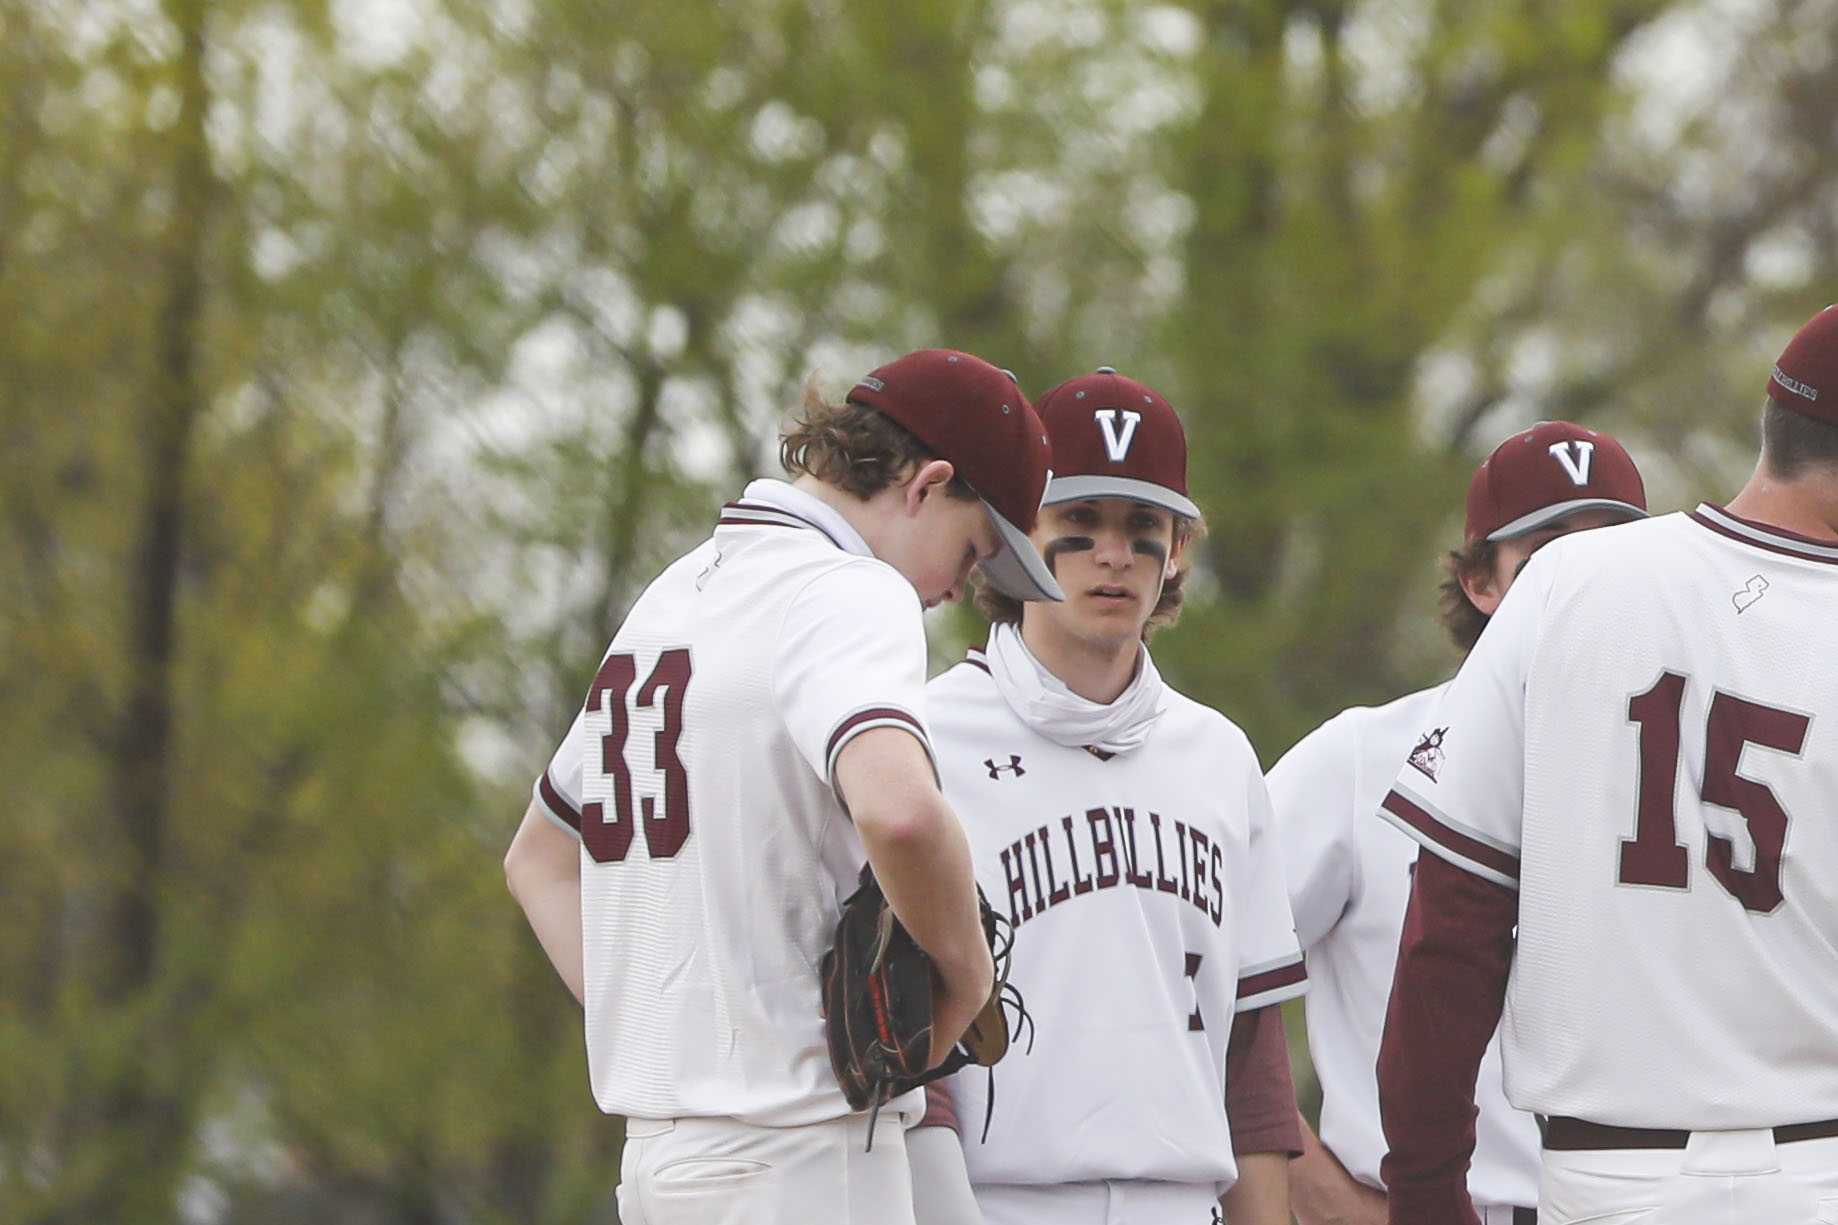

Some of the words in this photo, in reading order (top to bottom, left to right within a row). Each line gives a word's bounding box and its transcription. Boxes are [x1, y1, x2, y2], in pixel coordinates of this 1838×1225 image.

[1094, 407, 1143, 463] V
[1548, 439, 1595, 488] V
[580, 645, 694, 869] 33
[1615, 667, 1815, 917] 15
